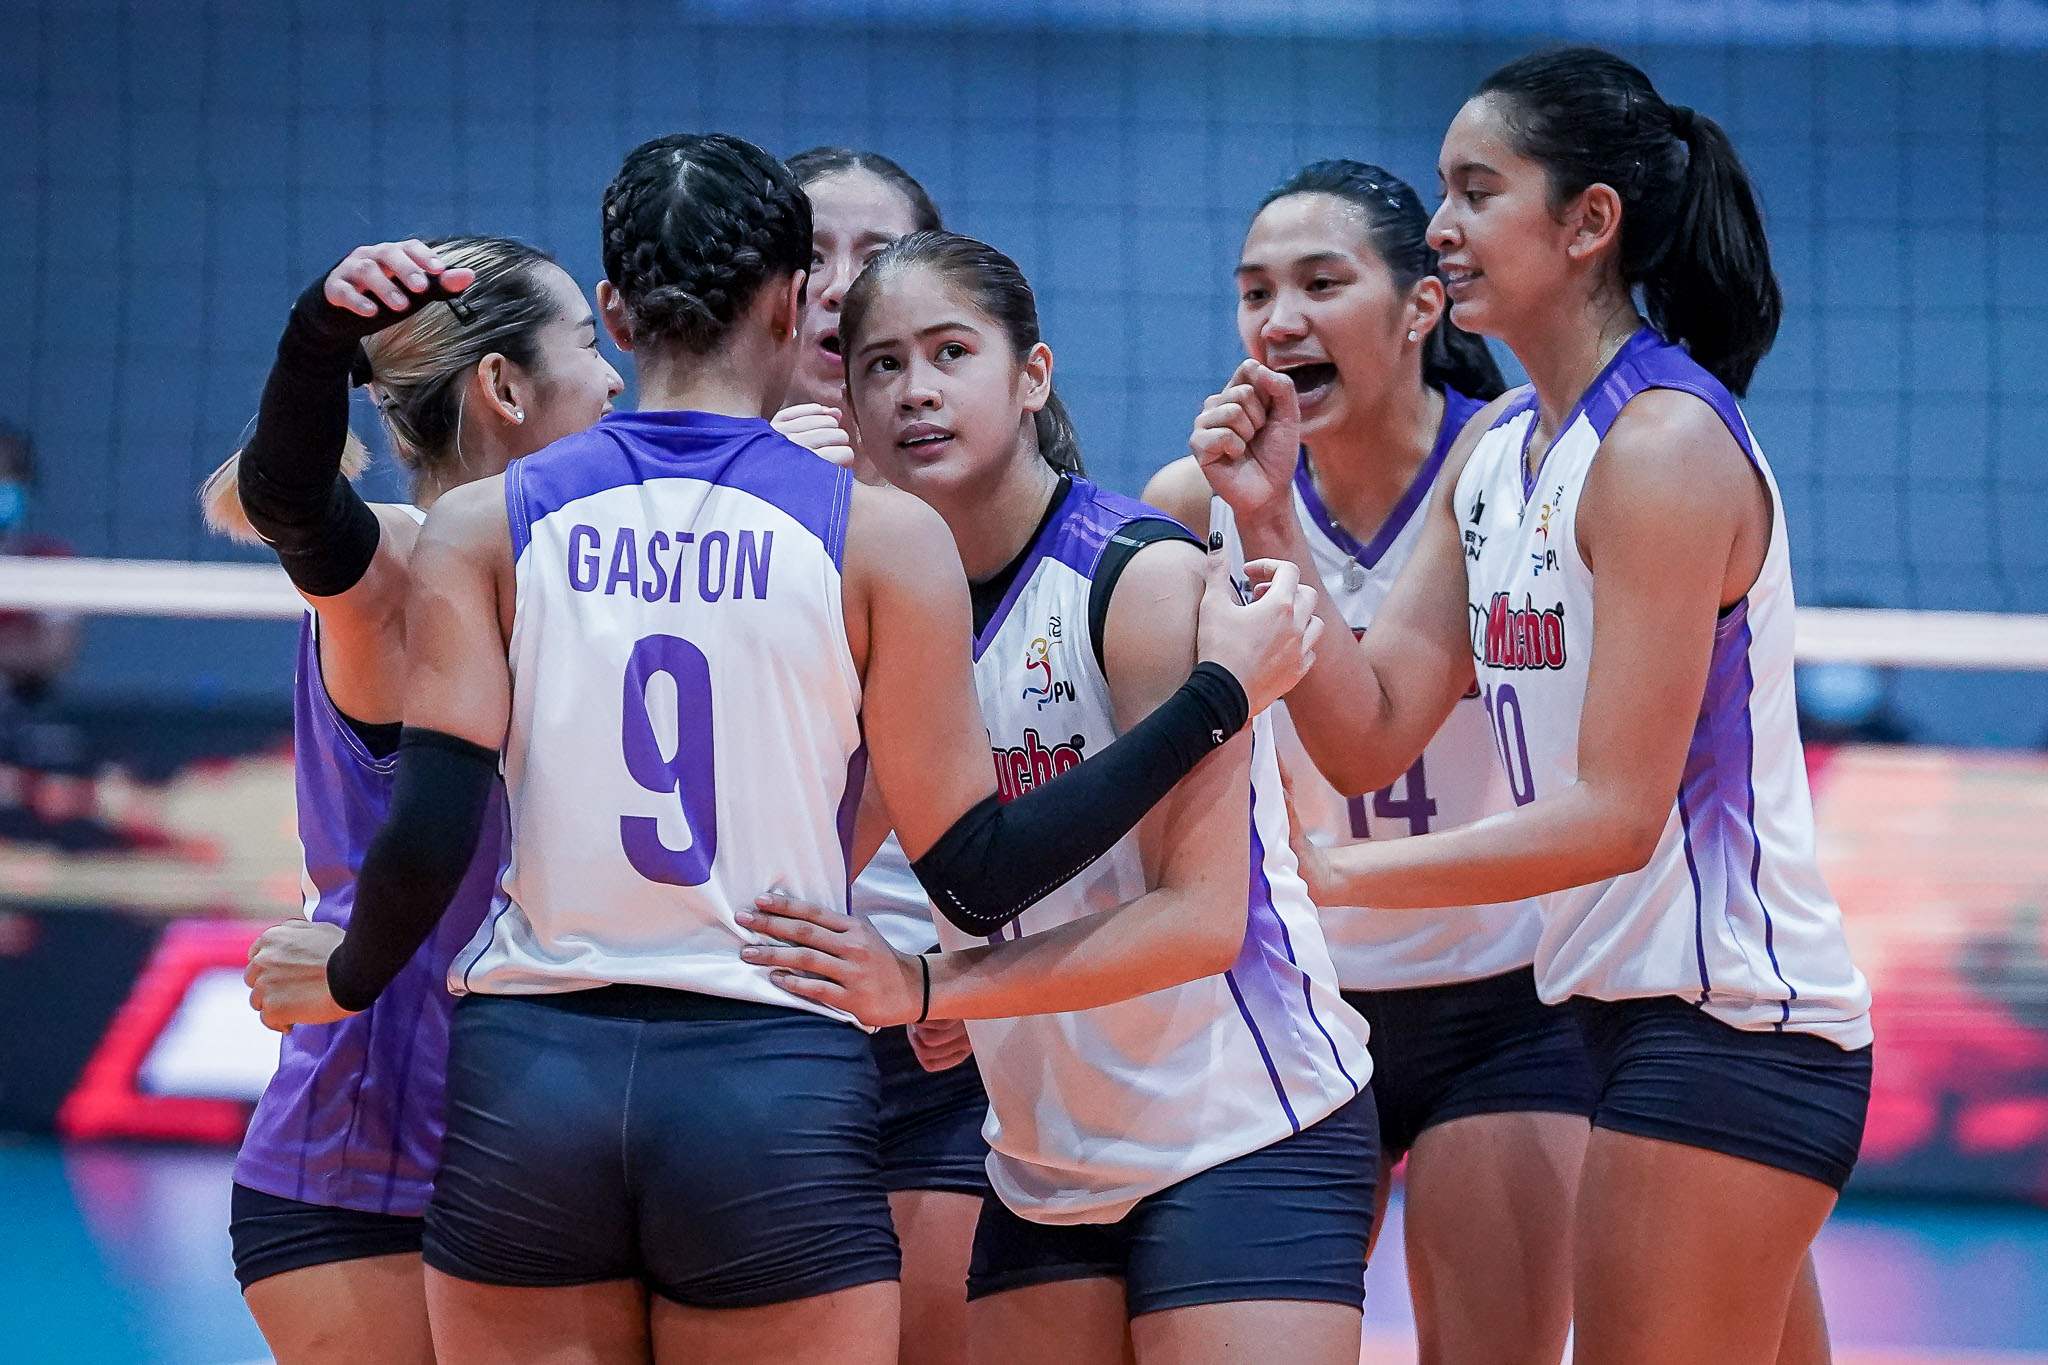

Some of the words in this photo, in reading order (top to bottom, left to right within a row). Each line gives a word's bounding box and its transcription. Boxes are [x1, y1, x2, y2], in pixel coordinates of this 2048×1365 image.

[567, 524, 773, 603] GASTON
[1485, 591, 1566, 670] Mucho
[620, 633, 718, 887] 9
[986, 728, 1086, 804] ucho
